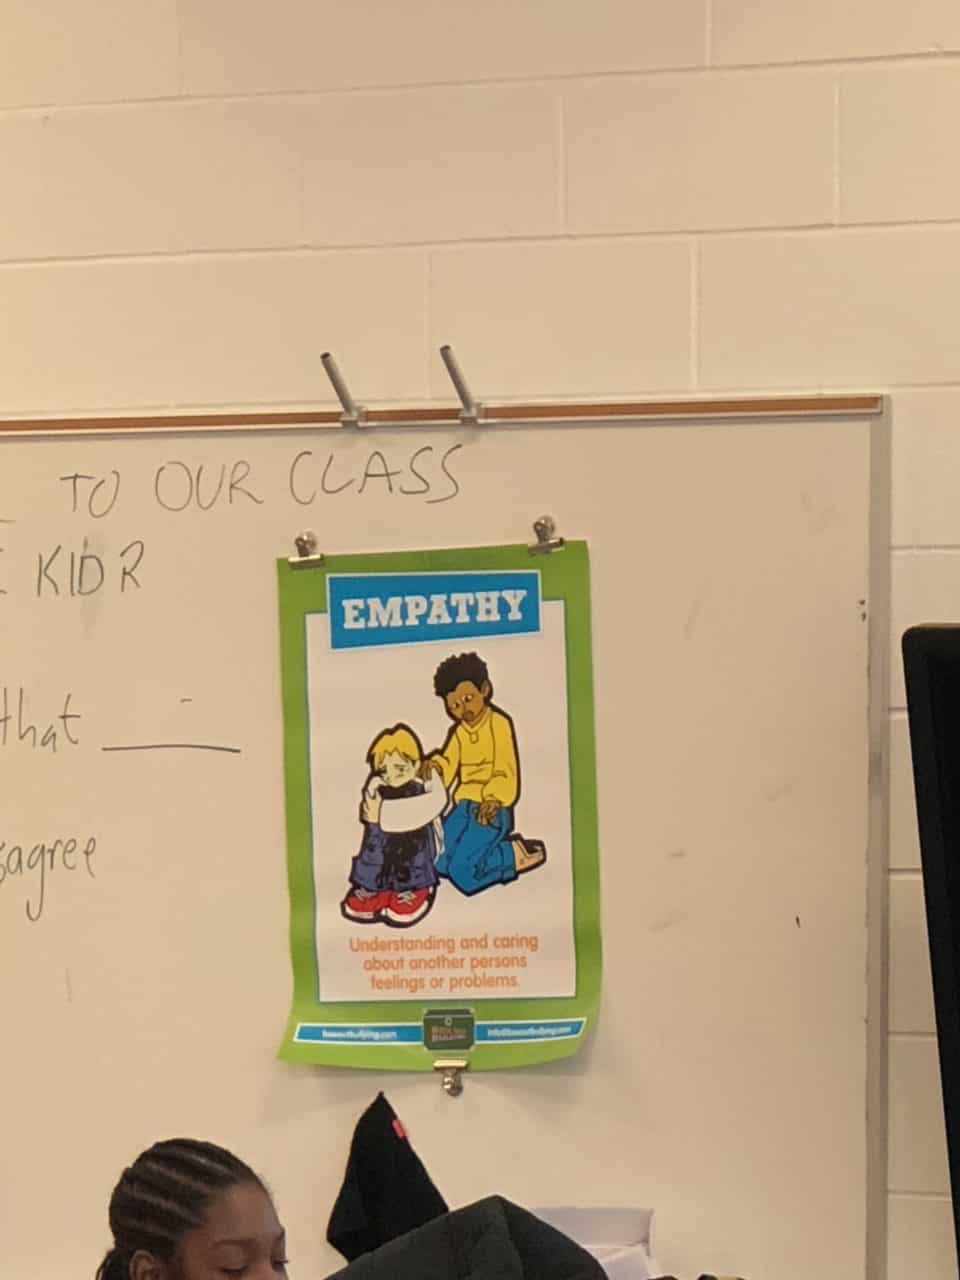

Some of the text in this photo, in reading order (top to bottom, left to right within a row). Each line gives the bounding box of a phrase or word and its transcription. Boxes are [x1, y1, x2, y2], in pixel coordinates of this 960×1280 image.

[60, 444, 463, 518] TO OUR CLASS
[341, 590, 527, 629] EMPATHY
[350, 933, 538, 953] Understanding and caring
[363, 955, 528, 973] about another persons
[371, 975, 424, 993] feelings
[430, 977, 445, 989] or
